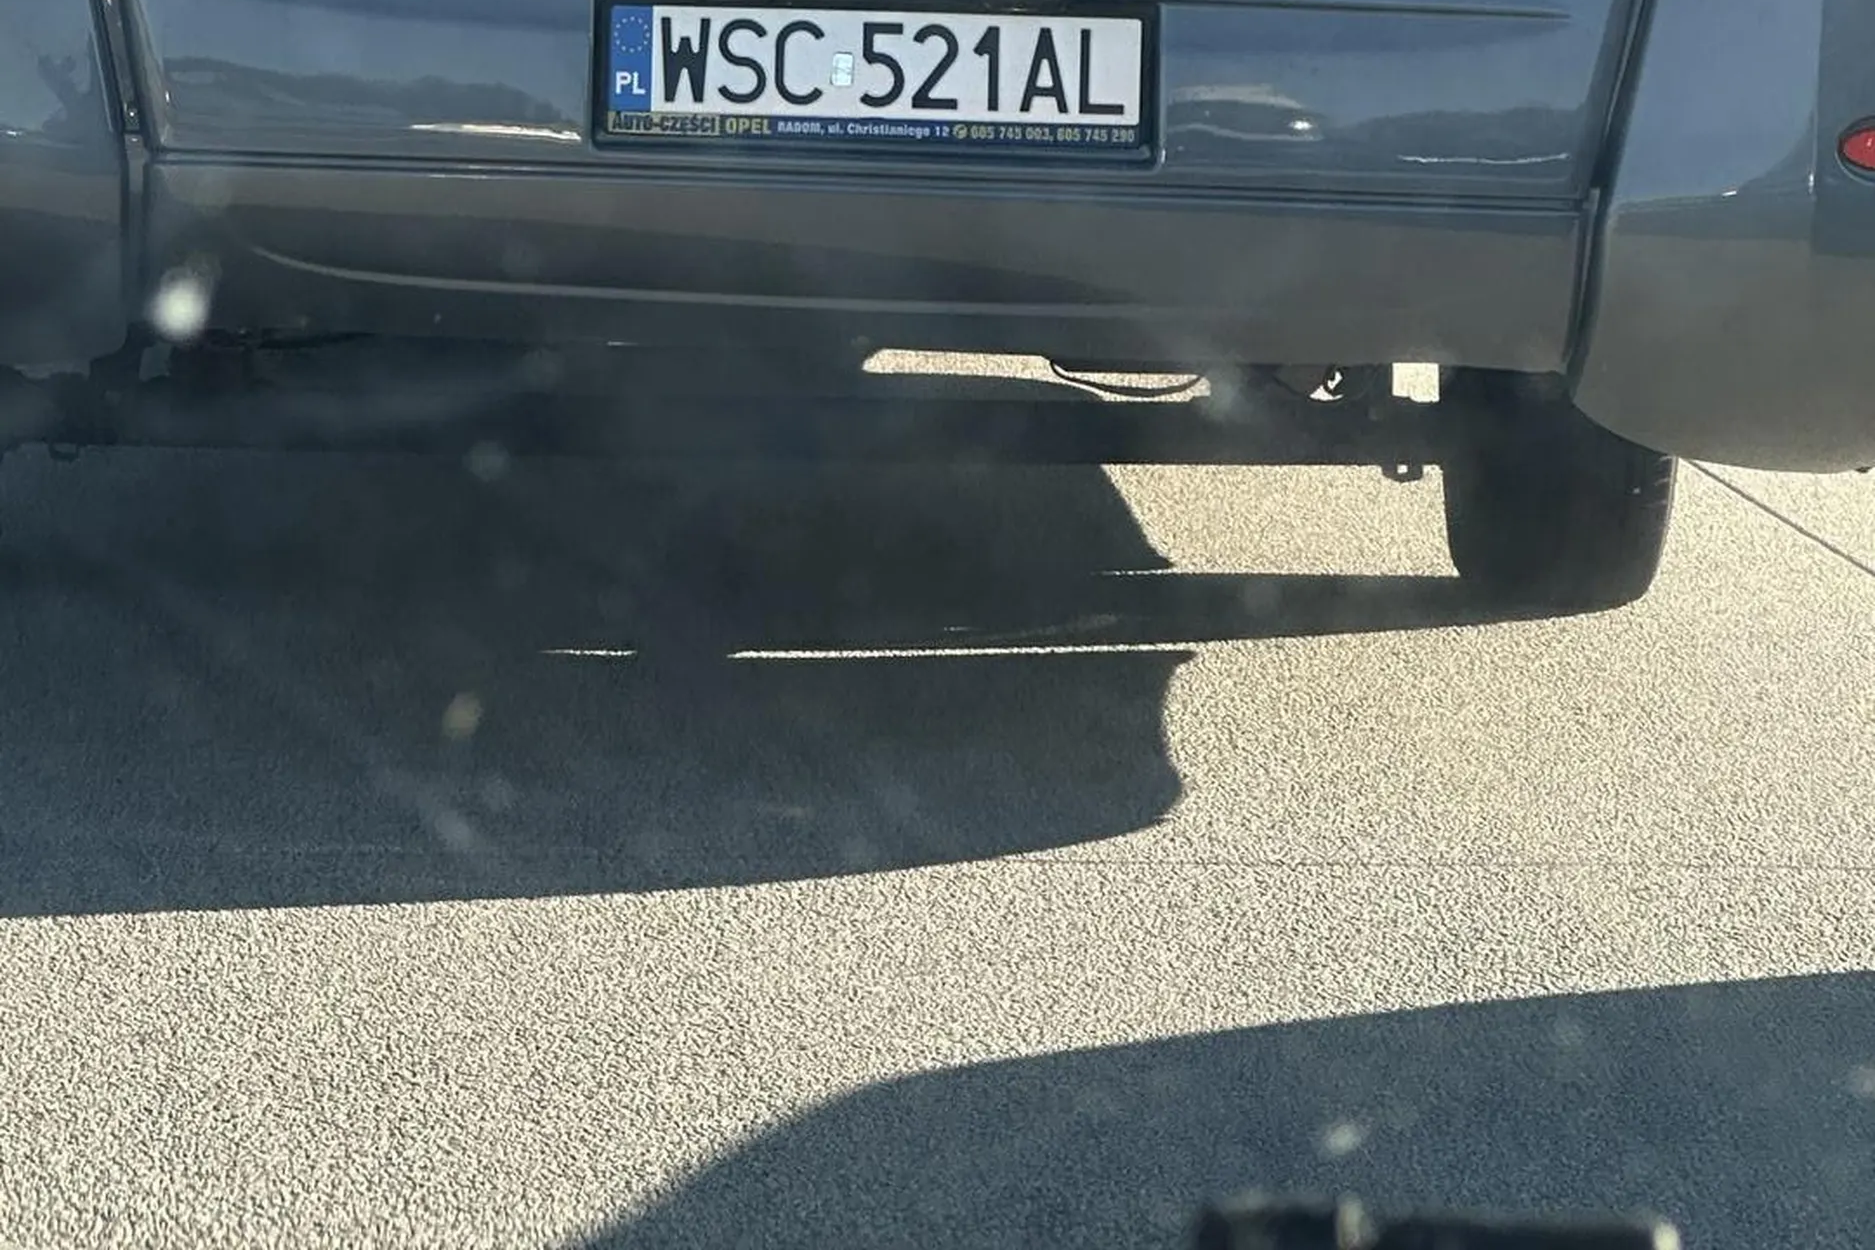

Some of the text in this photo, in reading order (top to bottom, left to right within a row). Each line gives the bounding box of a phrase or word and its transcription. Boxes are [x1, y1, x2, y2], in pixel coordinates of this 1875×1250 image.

[660, 16, 1125, 114] WSC 521AL
[614, 72, 646, 95] PL
[725, 118, 771, 135] OPEL
[935, 126, 949, 137] 12
